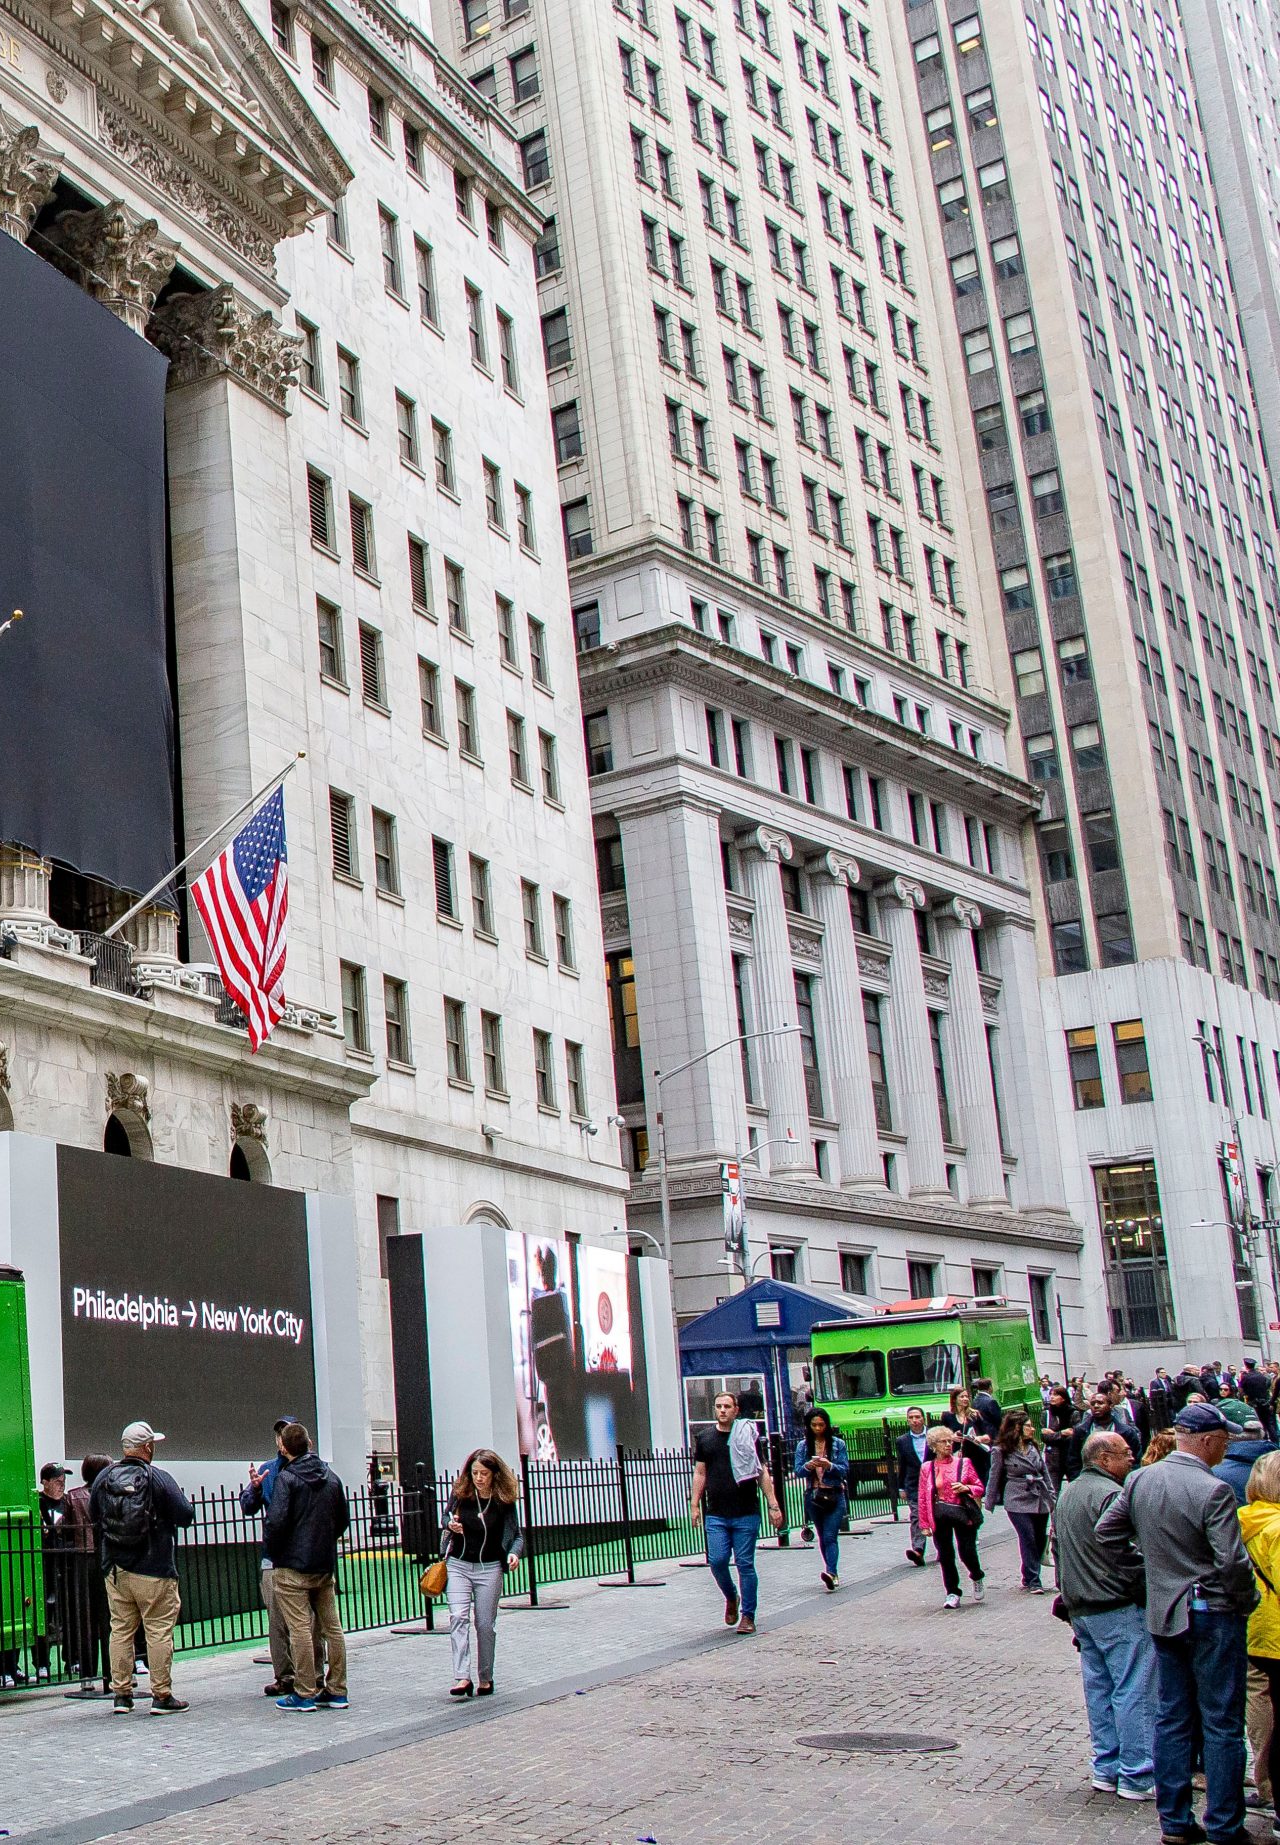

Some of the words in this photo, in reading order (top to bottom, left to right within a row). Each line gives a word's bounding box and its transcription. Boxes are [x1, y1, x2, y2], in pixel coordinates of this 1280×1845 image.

[73, 1287, 179, 1330] Philadelphia
[201, 1302, 238, 1332] New
[238, 1305, 273, 1335] York
[273, 1309, 304, 1344] City
